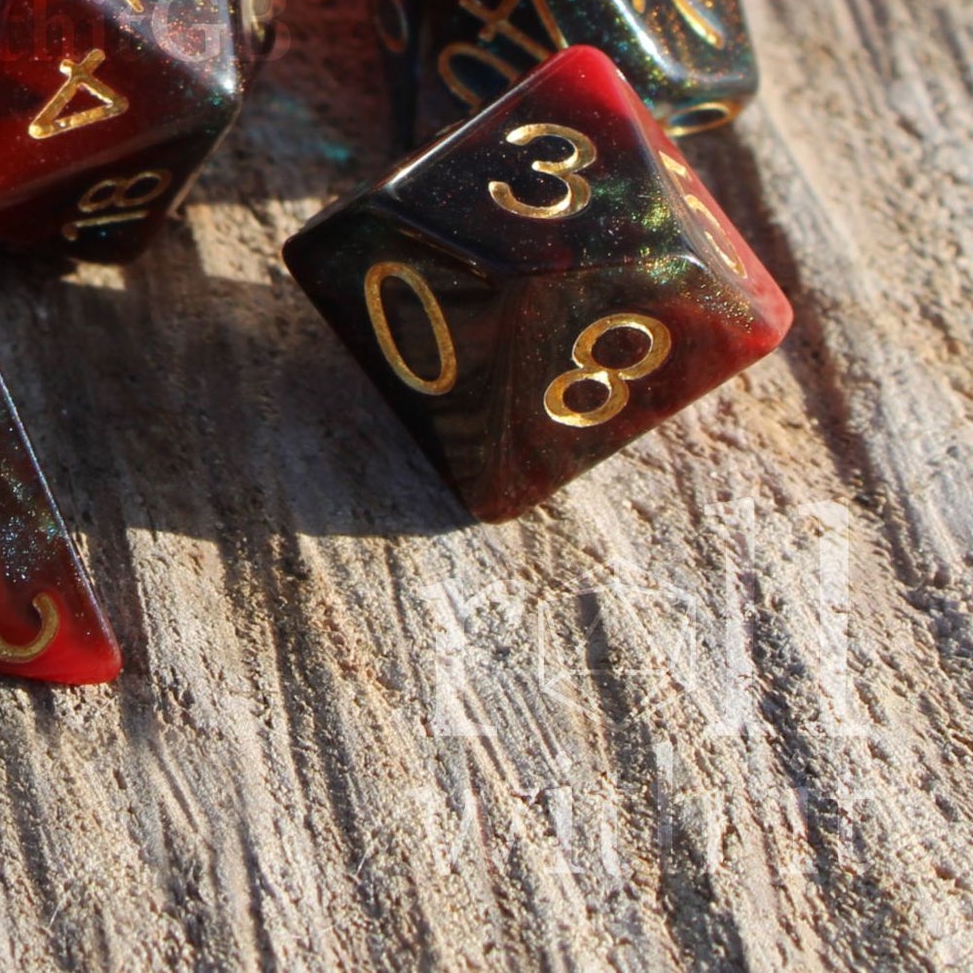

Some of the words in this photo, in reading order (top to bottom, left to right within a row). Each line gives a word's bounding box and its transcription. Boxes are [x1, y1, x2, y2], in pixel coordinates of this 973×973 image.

[28, 48, 128, 140] 4
[488, 123, 597, 219] 3
[363, 261, 458, 396] 0
[543, 312, 672, 428] 8
